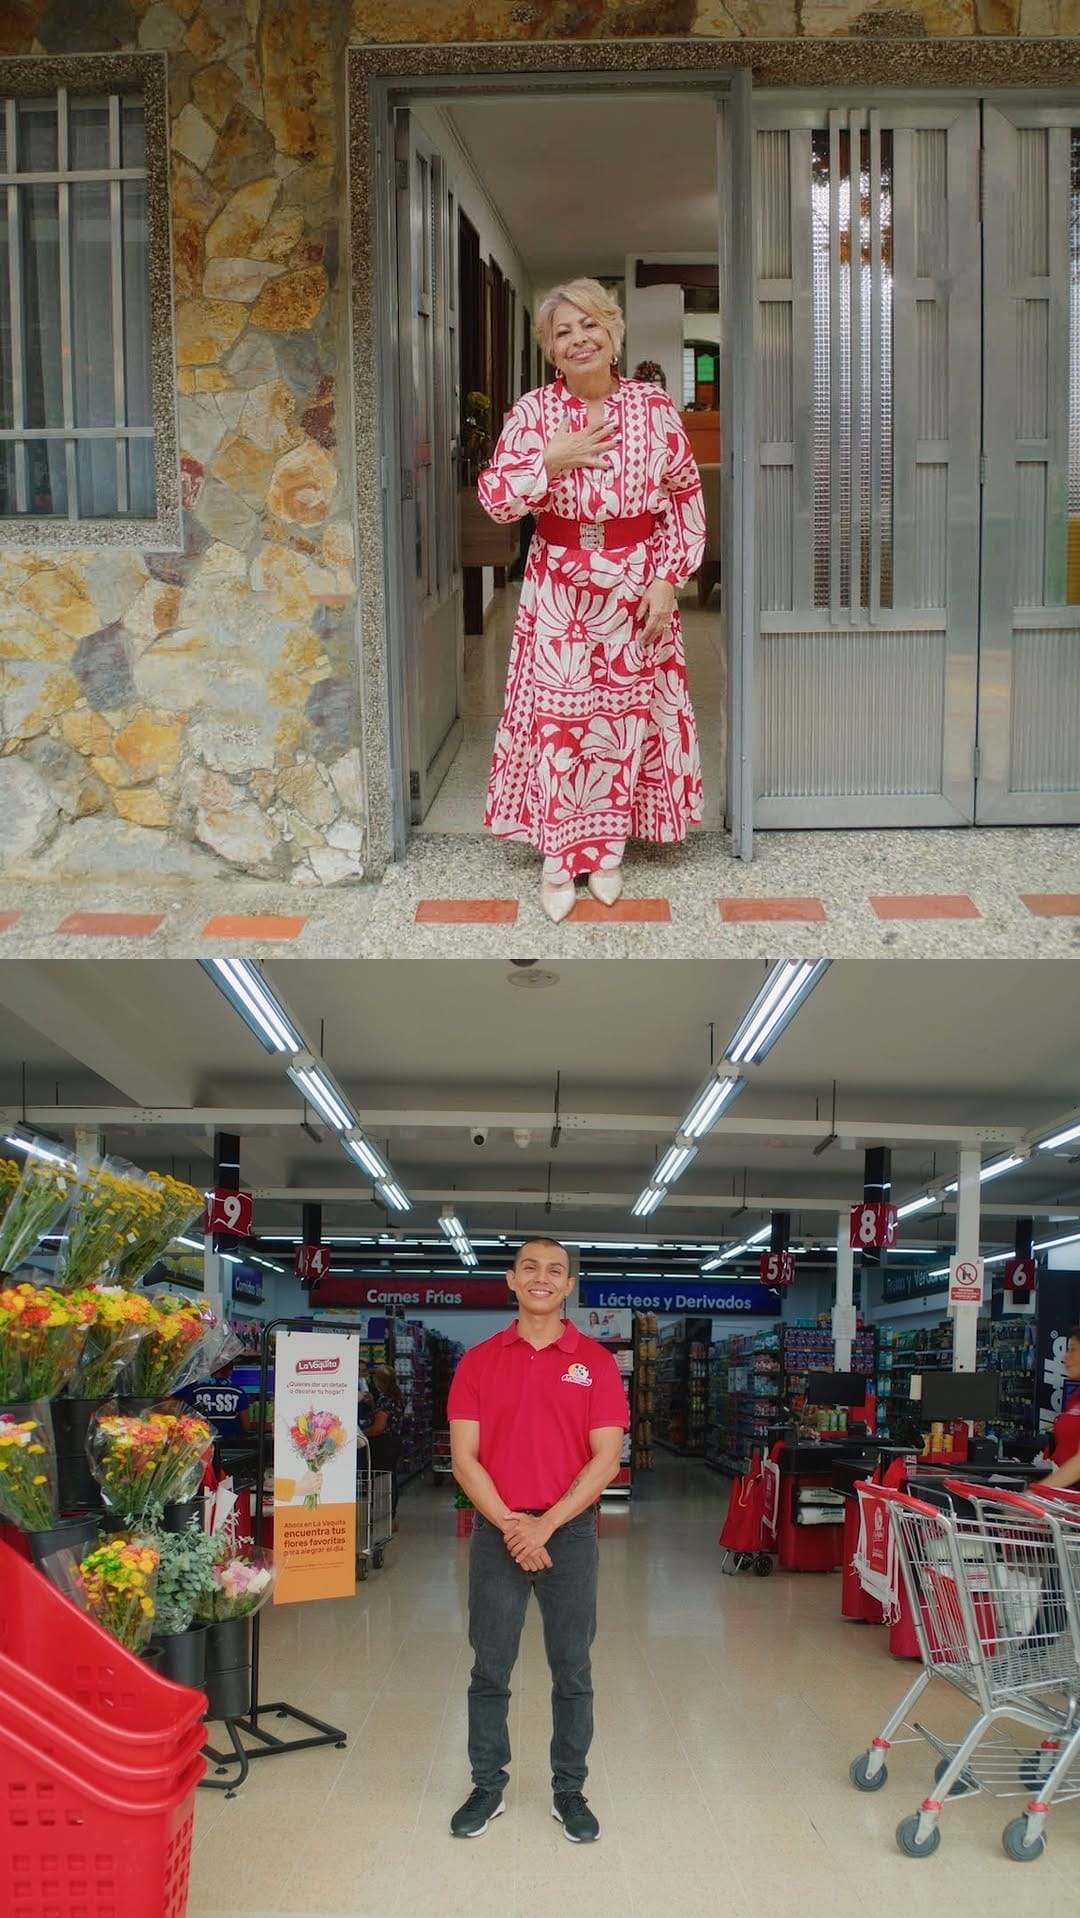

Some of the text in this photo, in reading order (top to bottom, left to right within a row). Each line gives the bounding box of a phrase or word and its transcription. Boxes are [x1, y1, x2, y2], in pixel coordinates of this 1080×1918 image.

[223, 1196, 241, 1229] 9
[859, 1209, 877, 1243] 8
[311, 1250, 323, 1274] 4
[767, 1256, 778, 1280] 5
[1012, 1263, 1027, 1287] 6
[366, 1288, 462, 1304] Carnes Frías
[599, 1293, 752, 1310] Lácteos y Derivados
[283, 1527, 346, 1538] encuentra tus
[283, 1537, 346, 1548] flores favoritas
